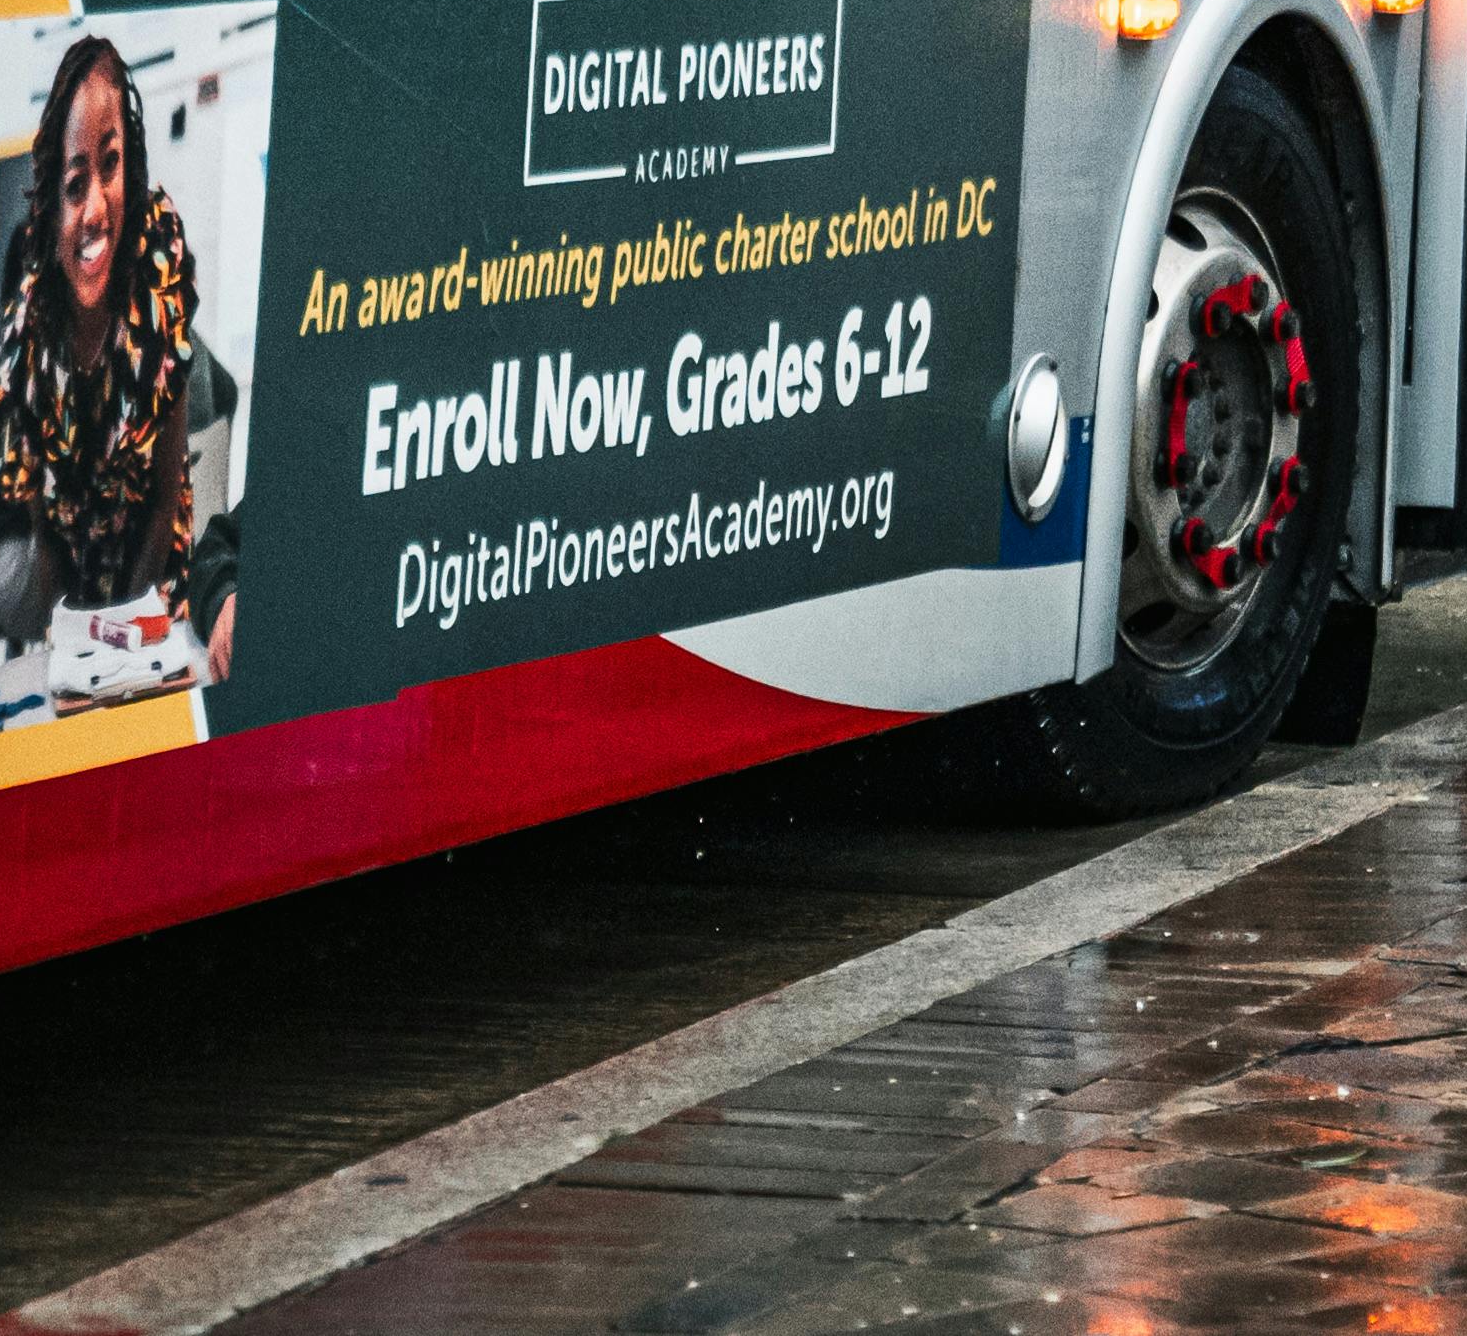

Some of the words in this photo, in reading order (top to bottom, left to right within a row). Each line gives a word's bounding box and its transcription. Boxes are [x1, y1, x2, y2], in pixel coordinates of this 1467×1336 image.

[544, 48, 667, 115] DIGITAL
[678, 32, 825, 102] PIONEERS
[635, 145, 729, 184] ACADEMY
[299, 268, 348, 337] An
[358, 232, 605, 329] award-winning
[611, 219, 707, 306] public
[714, 209, 821, 275] charter
[826, 187, 920, 261] school
[923, 185, 949, 245] in
[956, 176, 997, 241] DC
[362, 358, 520, 496] Enroll
[532, 351, 654, 458] Now,
[667, 320, 826, 437] Grades
[834, 295, 932, 408] 6-12
[396, 469, 895, 630] DigitalPioneersAcademy.org
